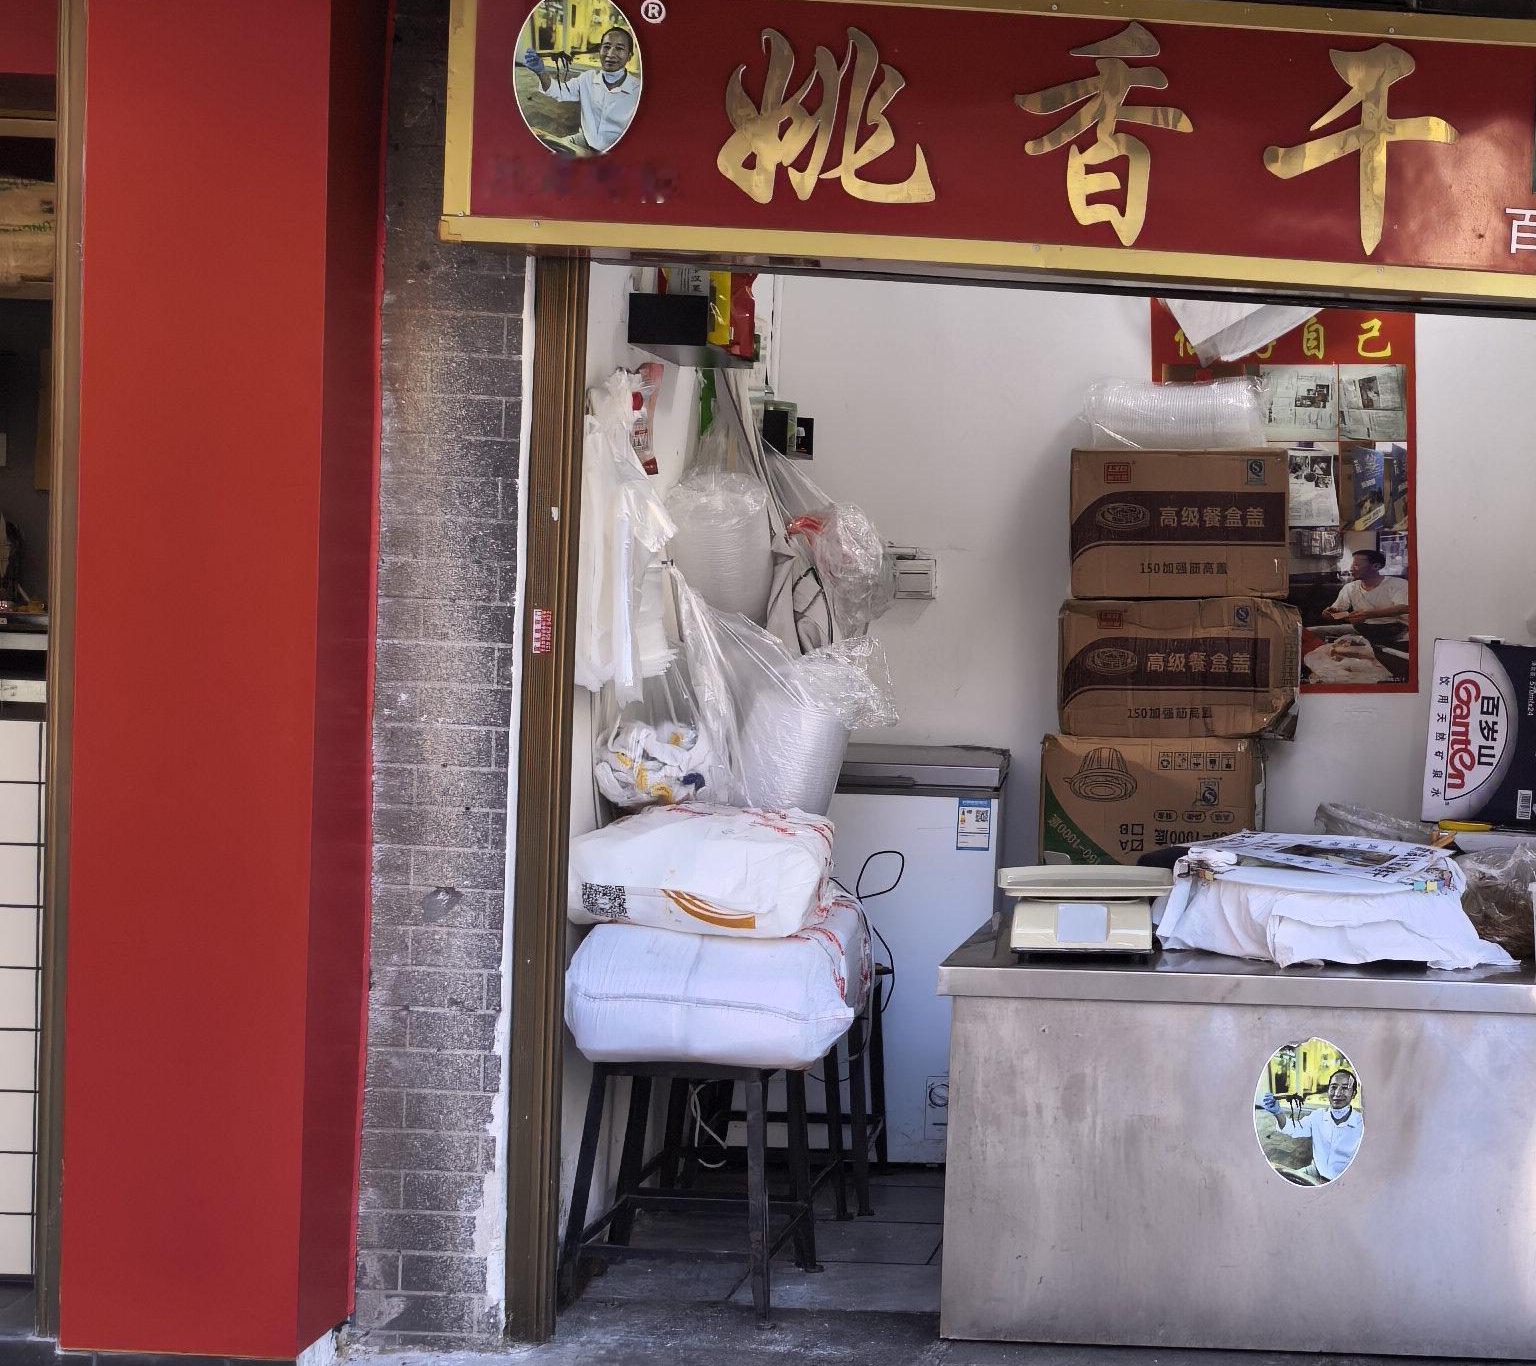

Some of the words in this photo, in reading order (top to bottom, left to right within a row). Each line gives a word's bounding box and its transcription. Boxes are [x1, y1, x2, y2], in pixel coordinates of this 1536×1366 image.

[1158, 505, 1265, 528] 高级餐盒盖
[1147, 652, 1250, 674] 高级餐盒盖
[1477, 695, 1500, 767] 百岁山
